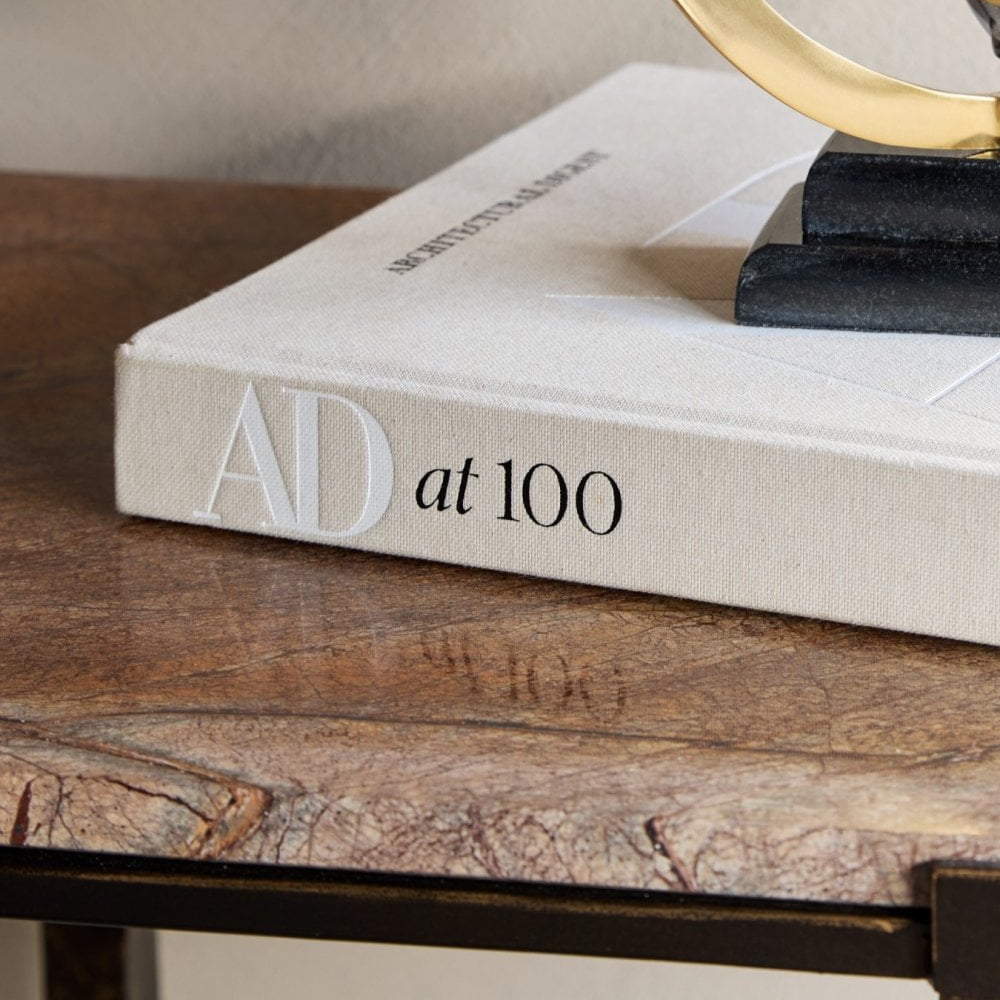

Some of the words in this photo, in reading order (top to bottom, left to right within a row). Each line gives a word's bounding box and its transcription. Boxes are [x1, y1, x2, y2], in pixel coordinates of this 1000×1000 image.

[192, 381, 395, 539] AD
[415, 457, 479, 515] at
[496, 458, 622, 536] 100
